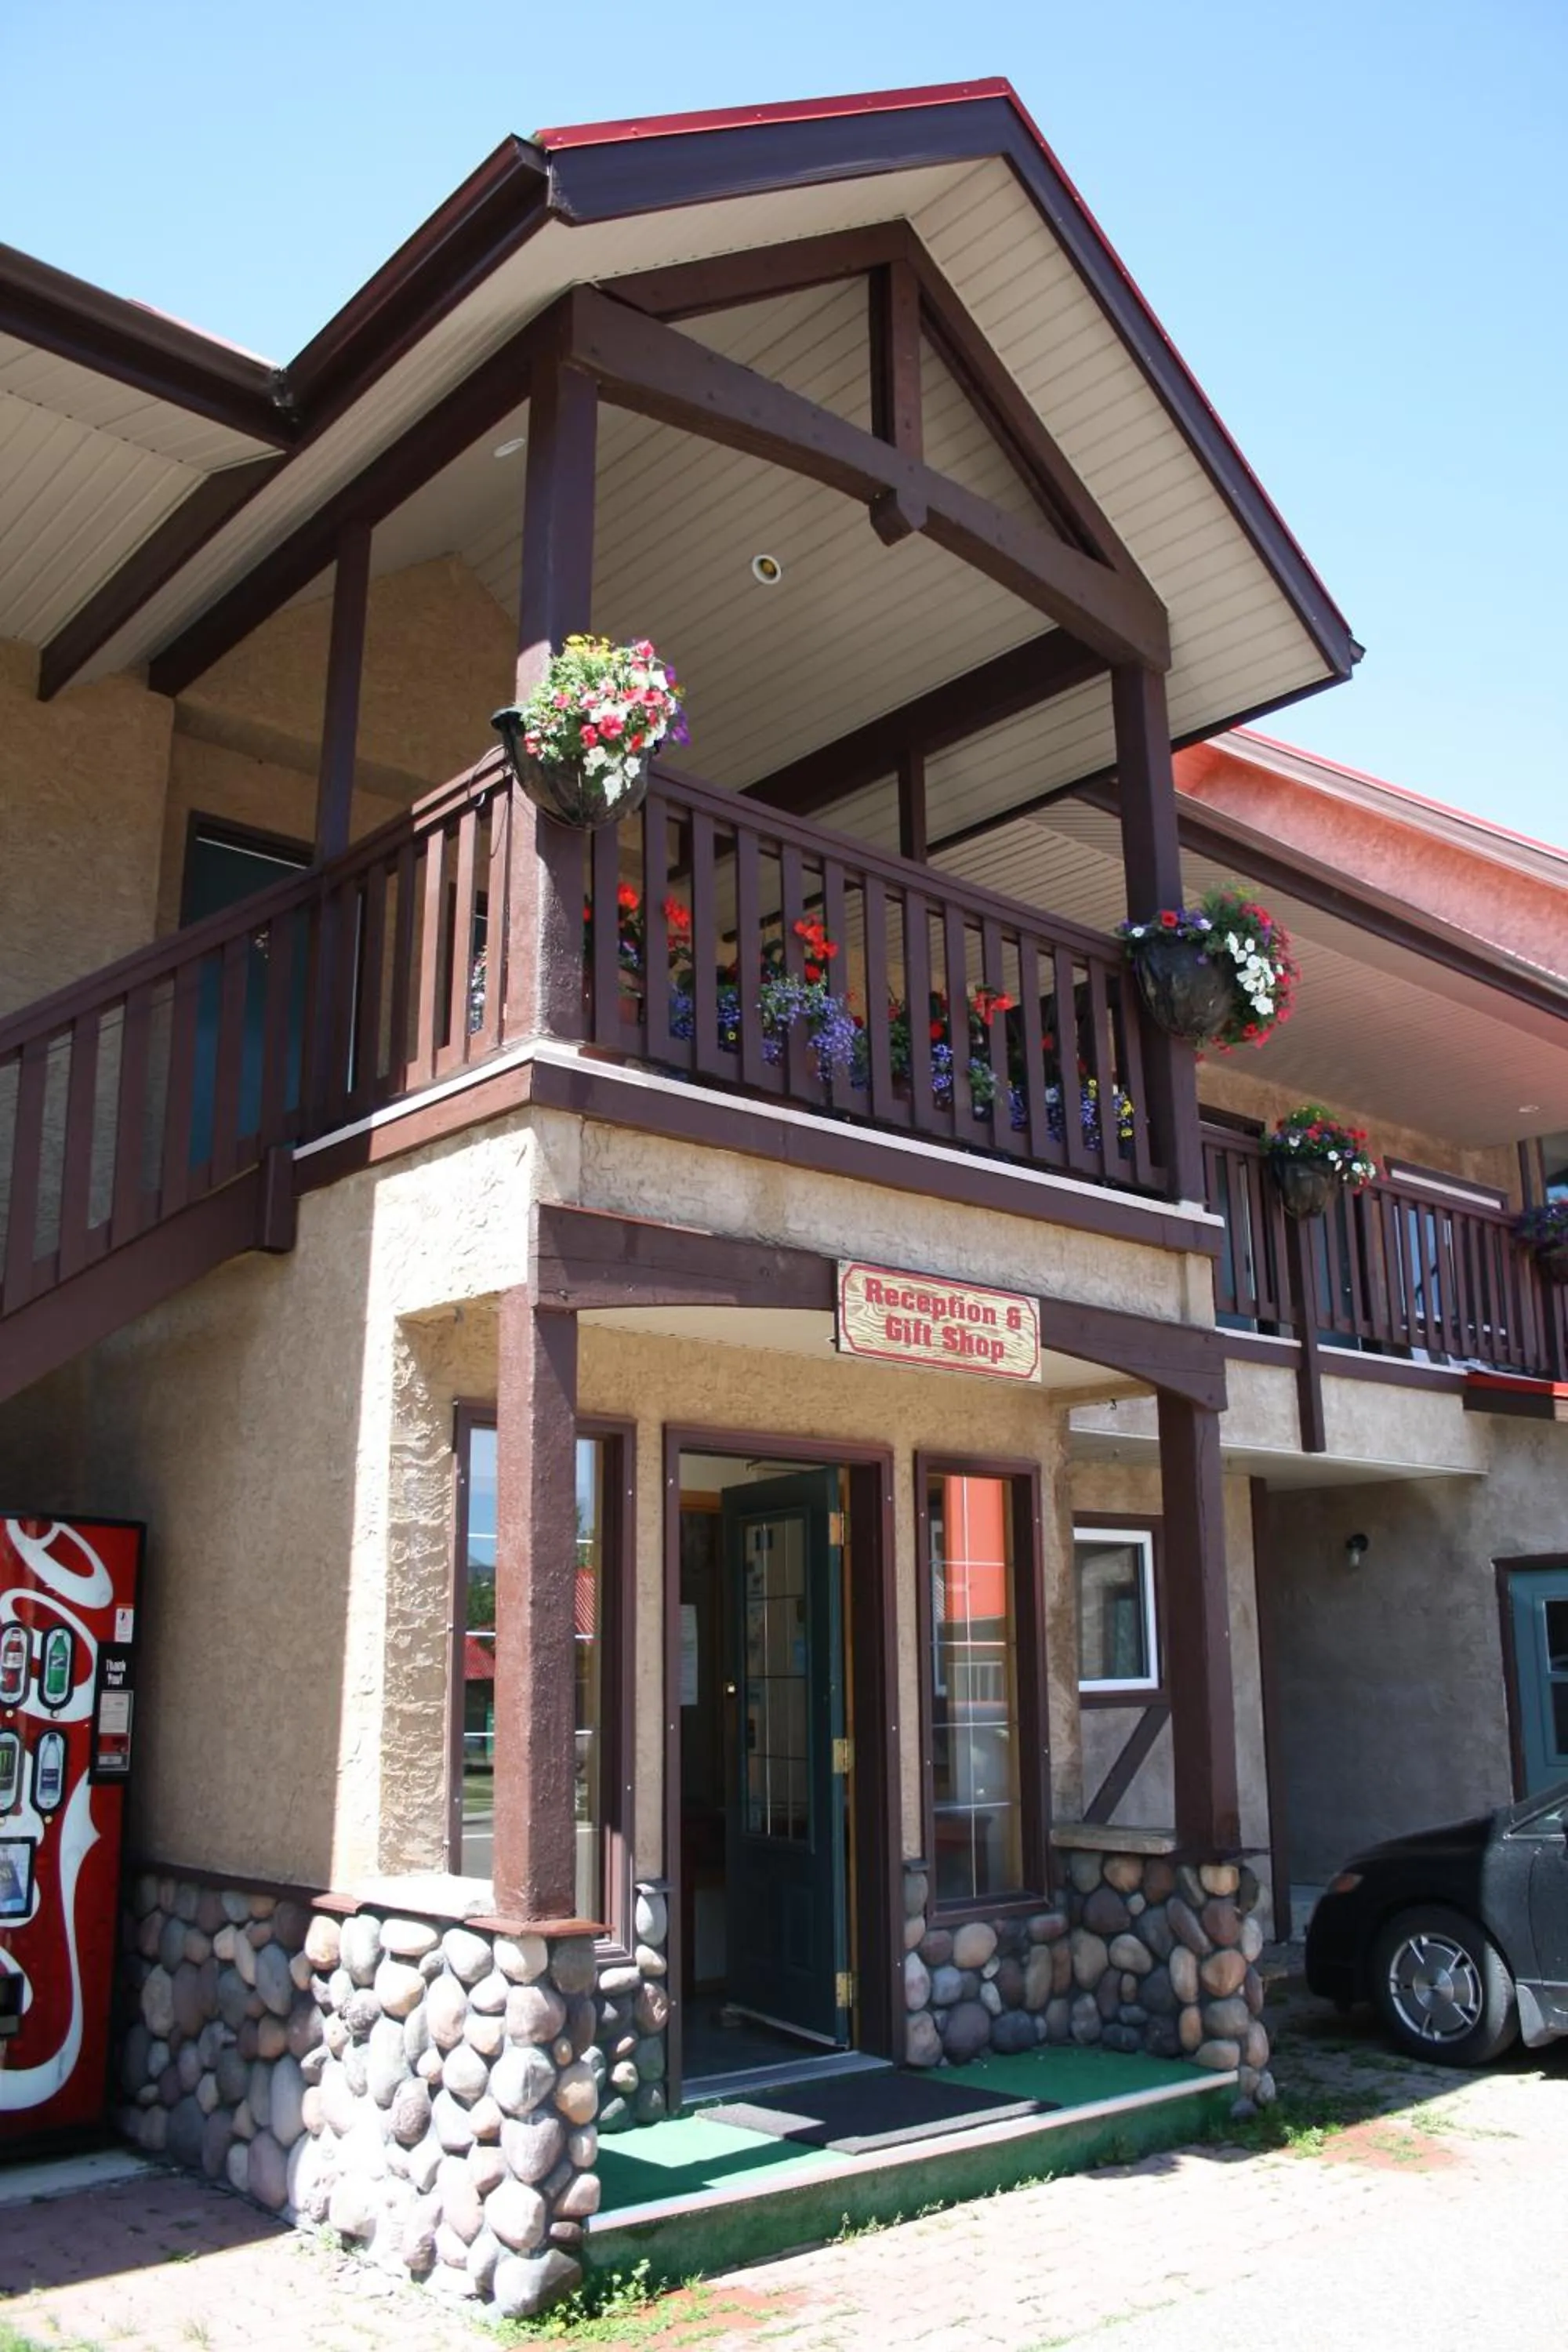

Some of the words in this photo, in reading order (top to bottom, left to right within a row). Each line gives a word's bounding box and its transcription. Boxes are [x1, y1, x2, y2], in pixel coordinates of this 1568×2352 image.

[865, 1278, 996, 1325] Reception
[1006, 1306, 1022, 1330] &
[885, 1315, 932, 1347] Gift
[942, 1326, 1004, 1364] Shop
